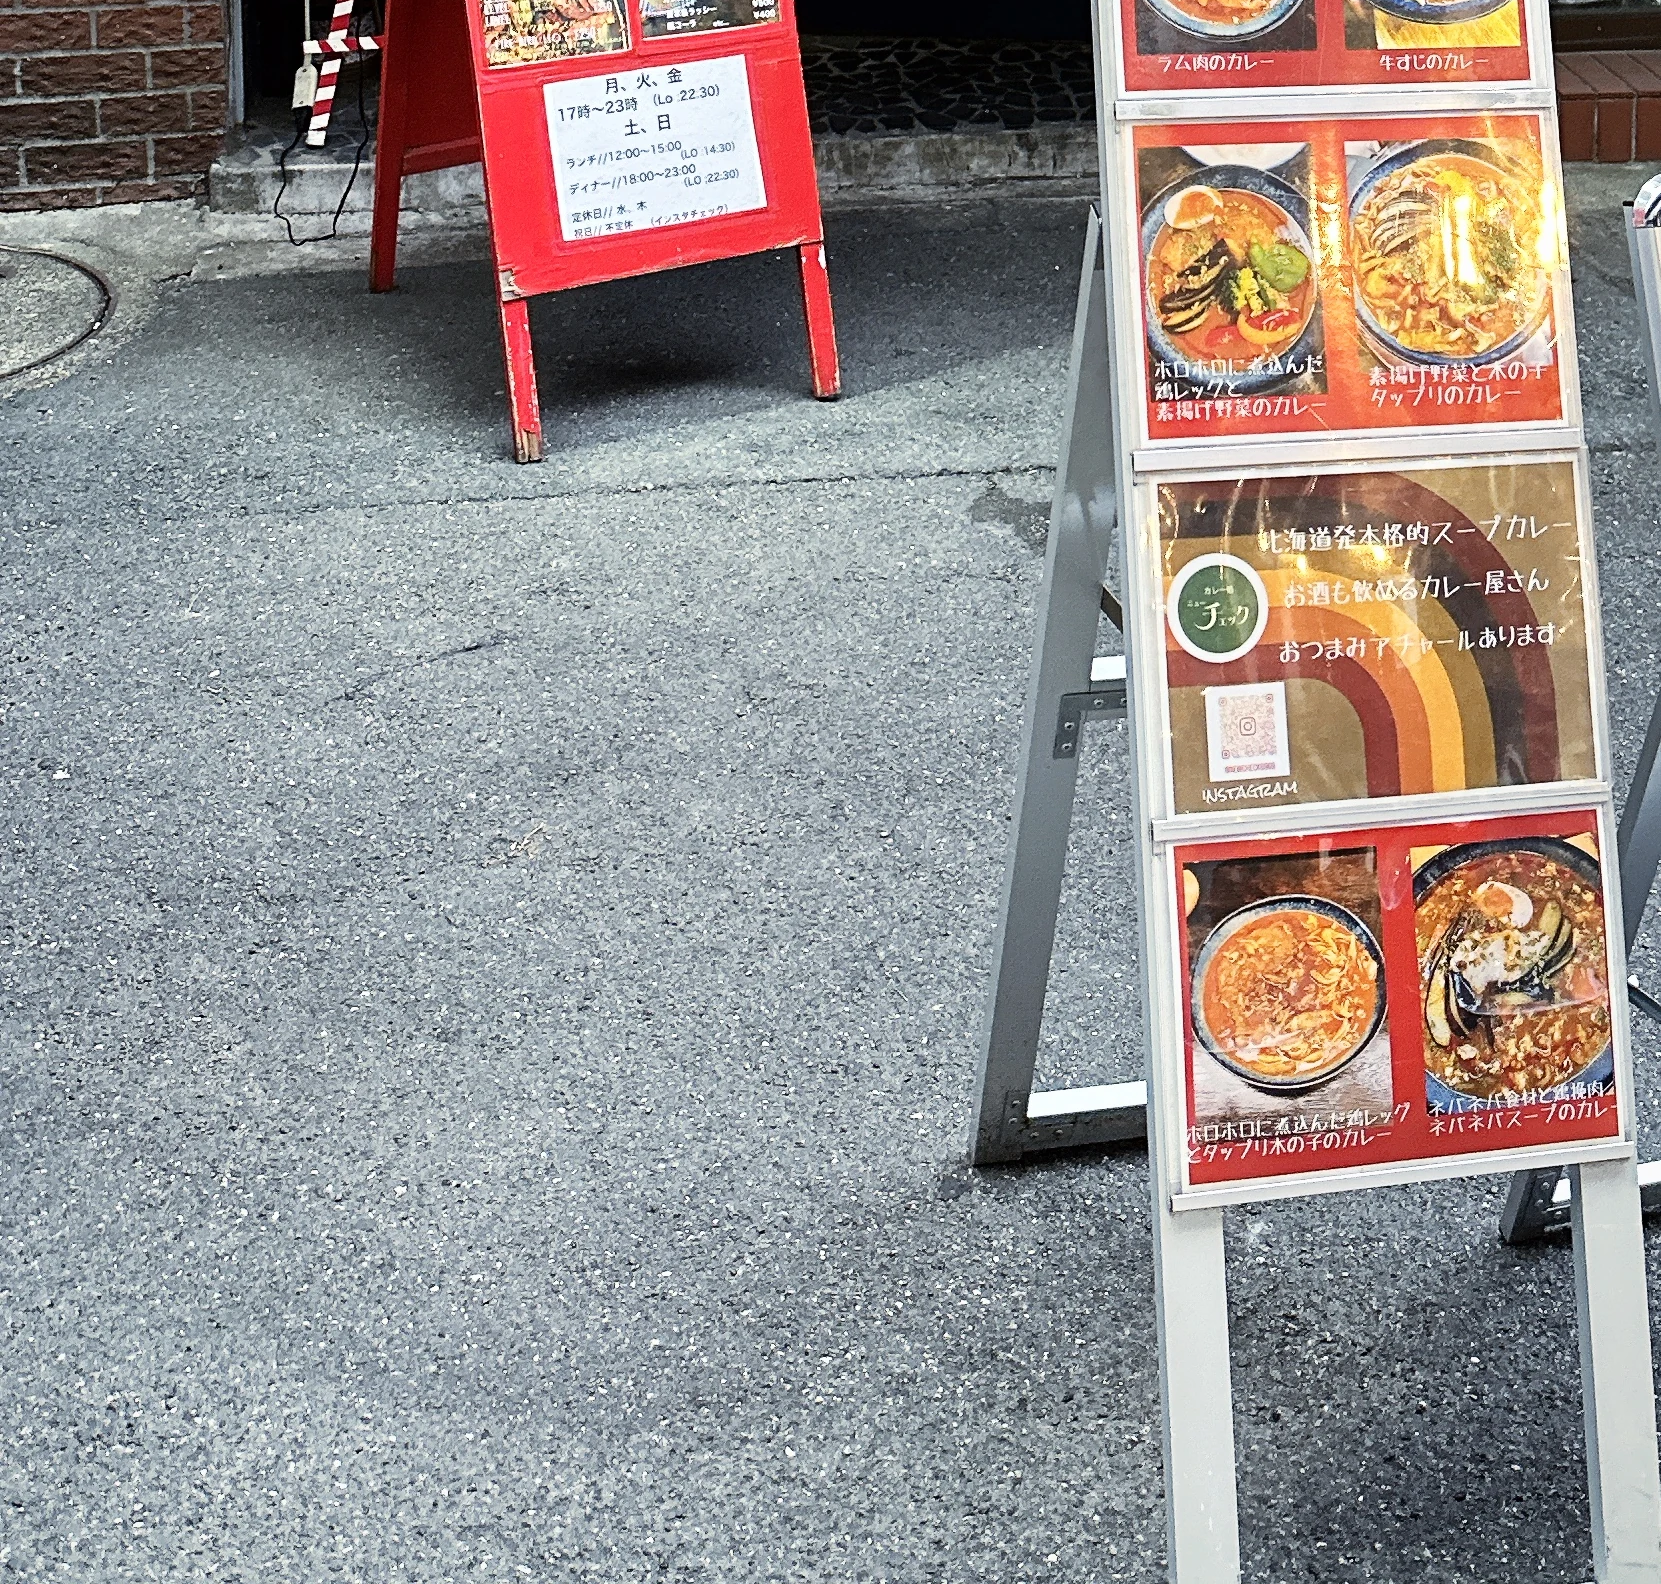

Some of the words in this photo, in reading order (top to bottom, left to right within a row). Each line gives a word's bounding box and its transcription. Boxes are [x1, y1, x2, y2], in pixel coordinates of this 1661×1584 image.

[1157, 54, 1275, 73] ラム肉のカレー
[1379, 54, 1489, 72] 牛すじのカレー
[605, 68, 683, 95] 月、火、金
[624, 114, 671, 137] 土、日
[1154, 354, 1324, 379] ホロホロに煮込んだ
[1369, 361, 1547, 387] 素揚げ野菜と木の子
[1156, 396, 1327, 421] 素揚げ野菜のカレー
[1371, 385, 1522, 408] タップリのカレー
[1268, 515, 1572, 554] 北海道発本格的スープカレー
[1284, 569, 1550, 607] お酒も飲めるカレー屋さん
[1279, 624, 1556, 664] おつまみアチャールあります
[1202, 781, 1298, 804] INSTAGRAM
[1429, 1081, 1605, 1117] ネバネバ食材と鶏挽肉
[1187, 1128, 1392, 1164] とタップリ木の子のカレー
